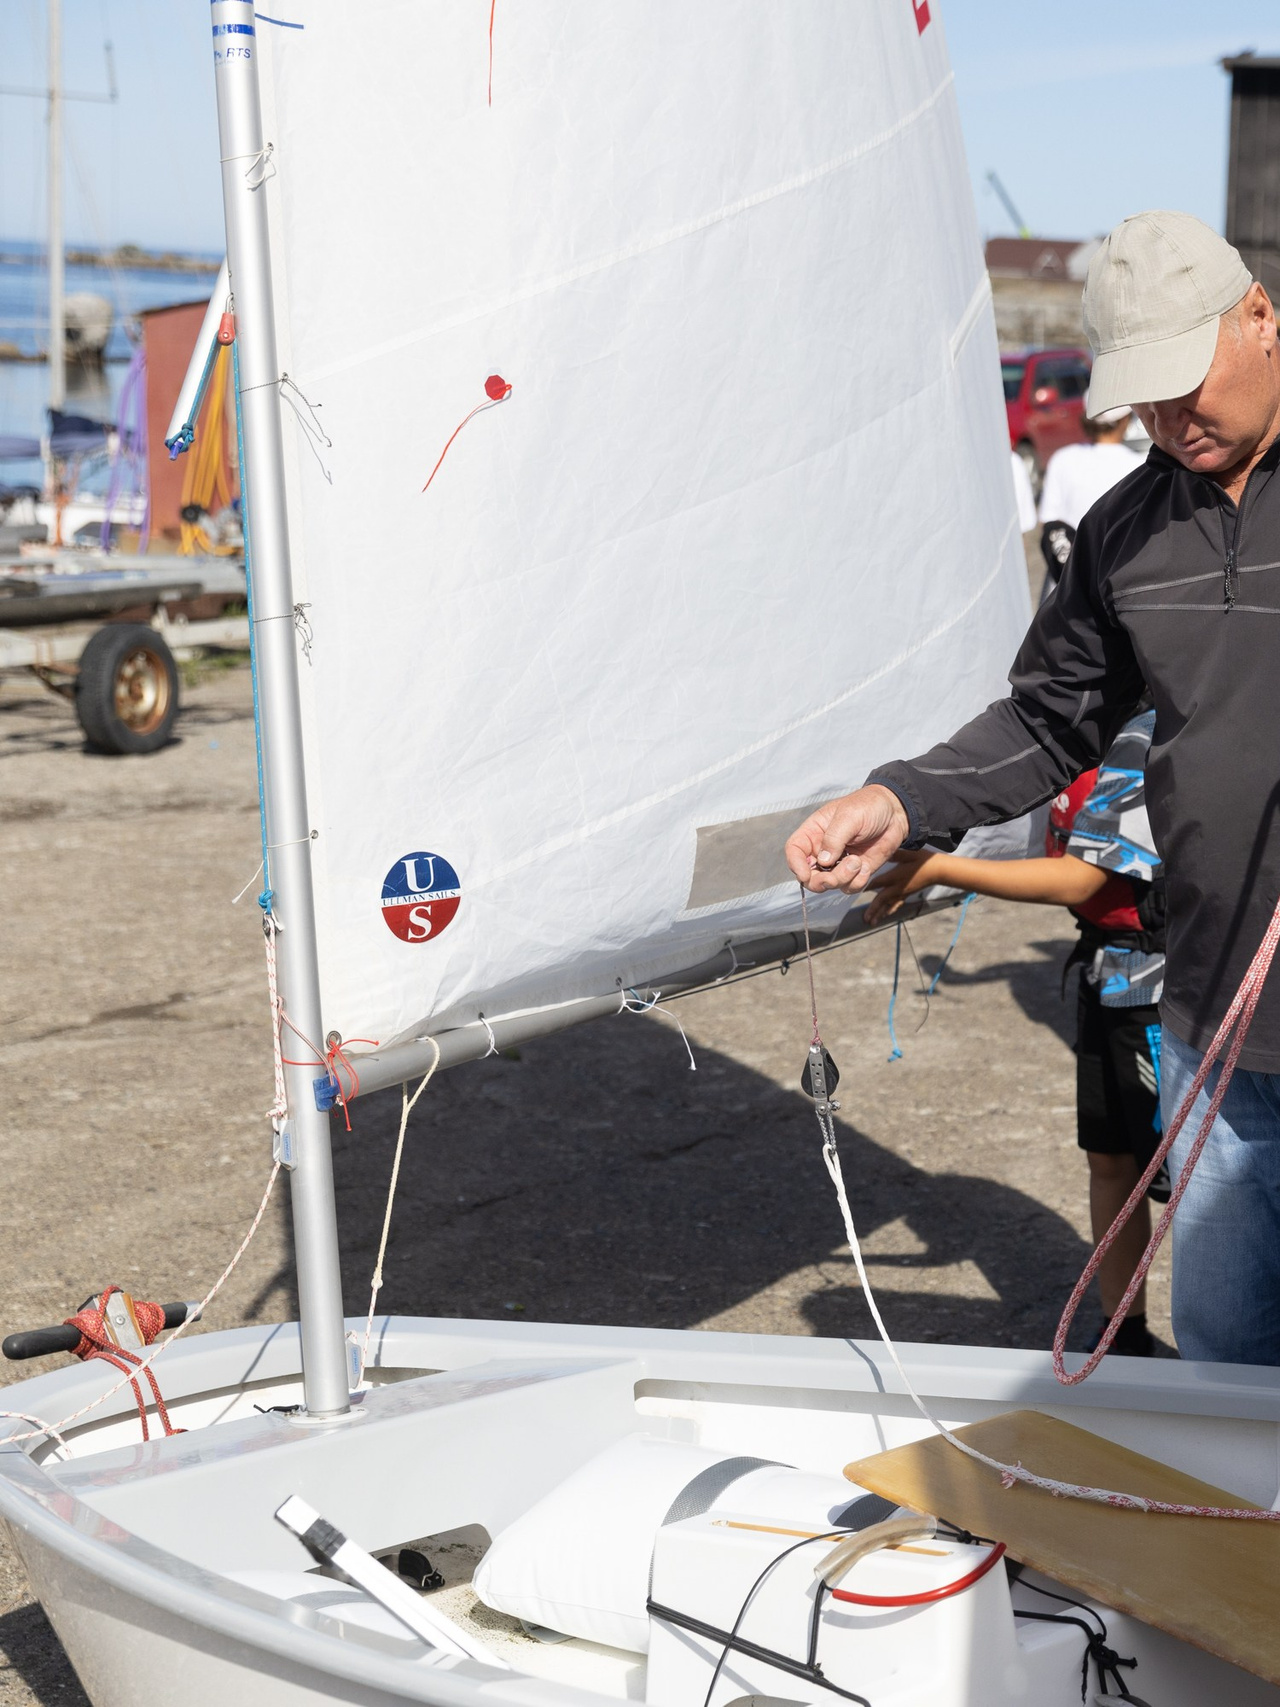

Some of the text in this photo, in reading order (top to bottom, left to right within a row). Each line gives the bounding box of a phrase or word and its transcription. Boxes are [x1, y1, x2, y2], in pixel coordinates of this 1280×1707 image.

[400, 856, 437, 893] U
[383, 894, 426, 907] ULLMAN
[407, 904, 432, 940] S
